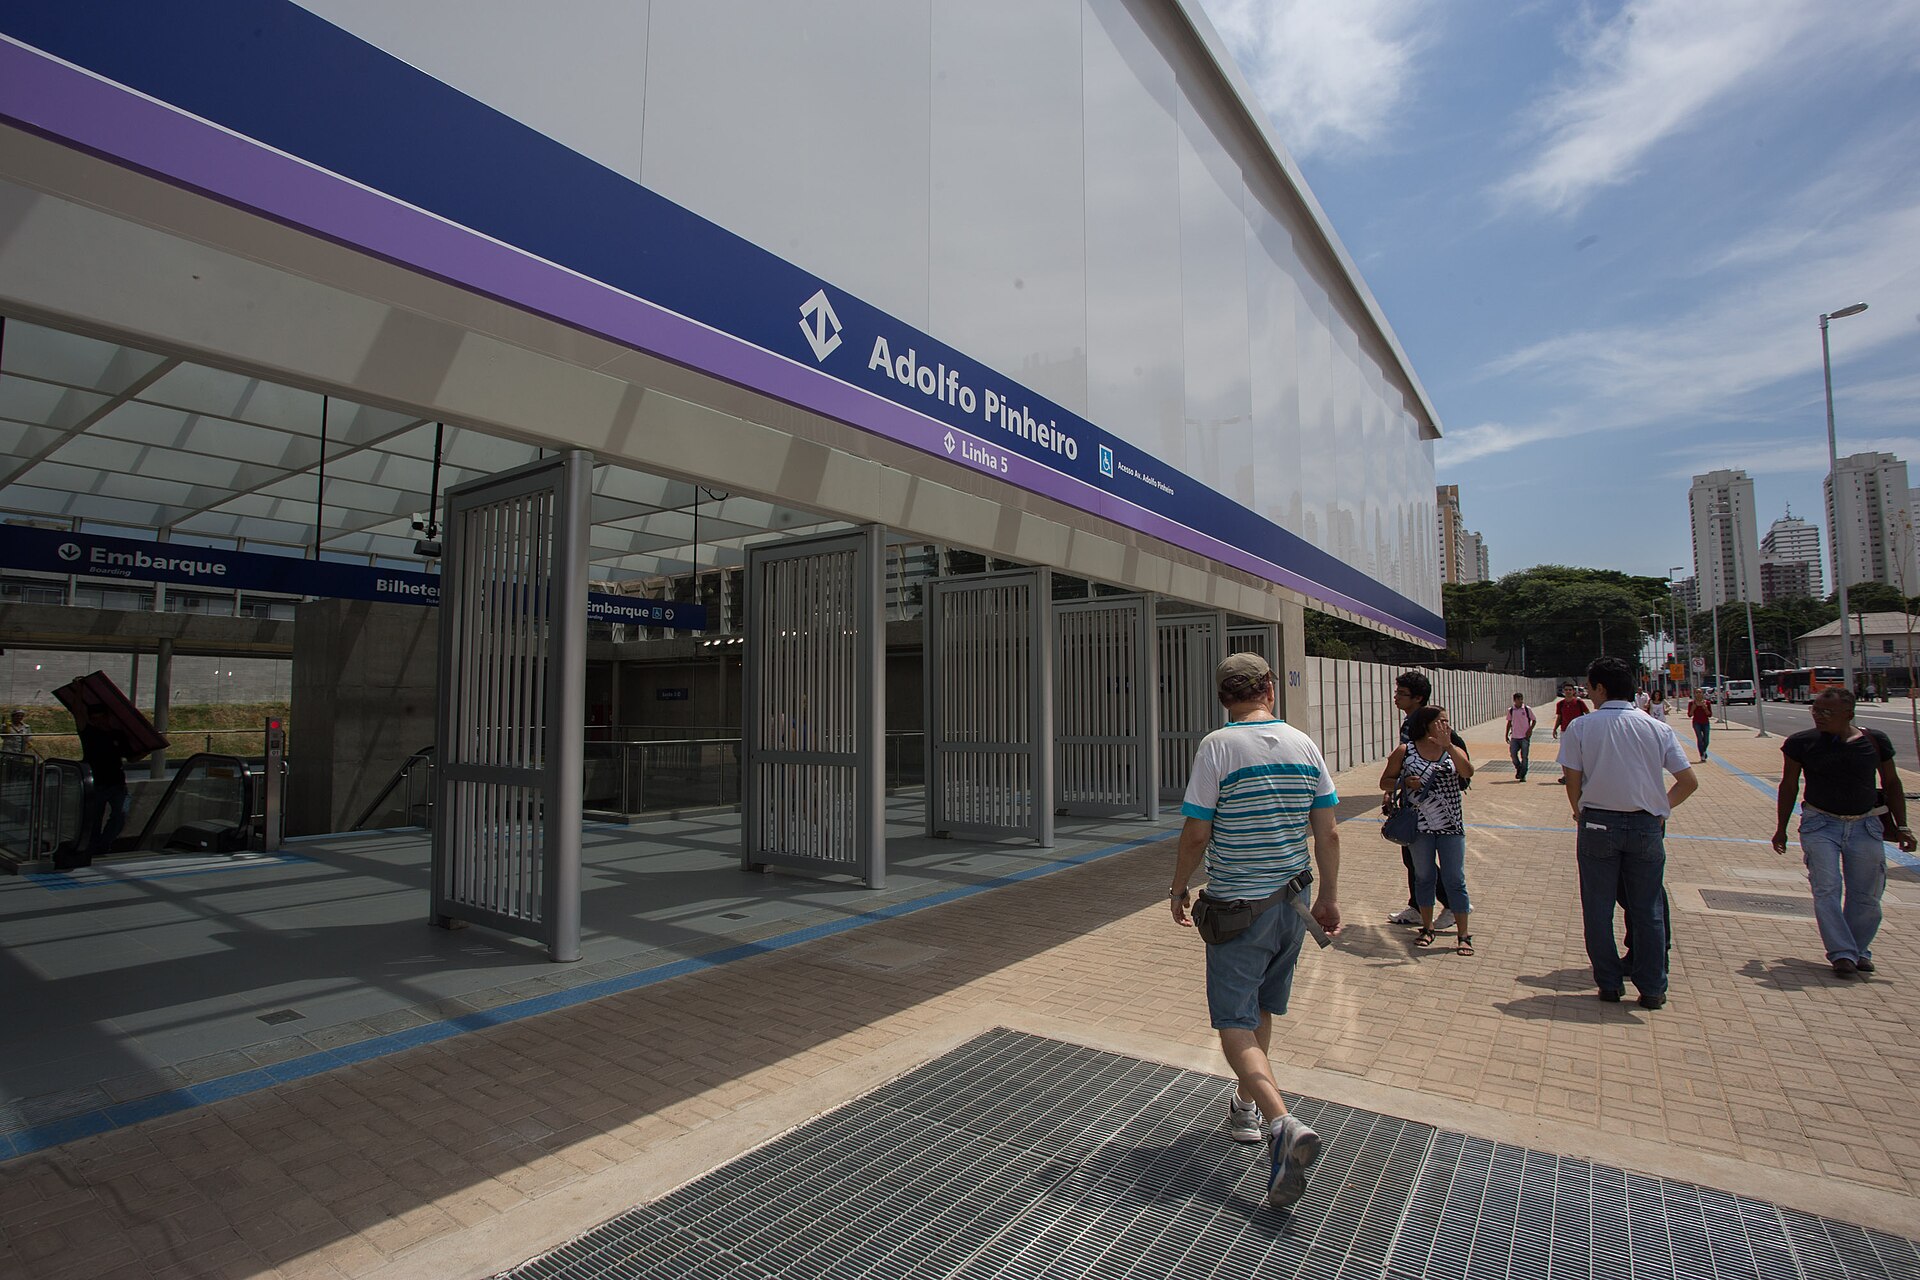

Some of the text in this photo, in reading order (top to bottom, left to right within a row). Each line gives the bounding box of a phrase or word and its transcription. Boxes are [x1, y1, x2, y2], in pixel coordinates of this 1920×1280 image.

[868, 335, 1079, 461] Adolfo Pinheiro
[961, 440, 1009, 474] Linha 5
[1117, 461, 1175, 496] Acesso Av. Adolfo Pinheiro
[89, 547, 227, 576] Embarque
[89, 566, 132, 578] Boarding
[376, 578, 441, 597] Bilheter
[587, 601, 650, 619] Embarque
[1288, 670, 1301, 687] 301
